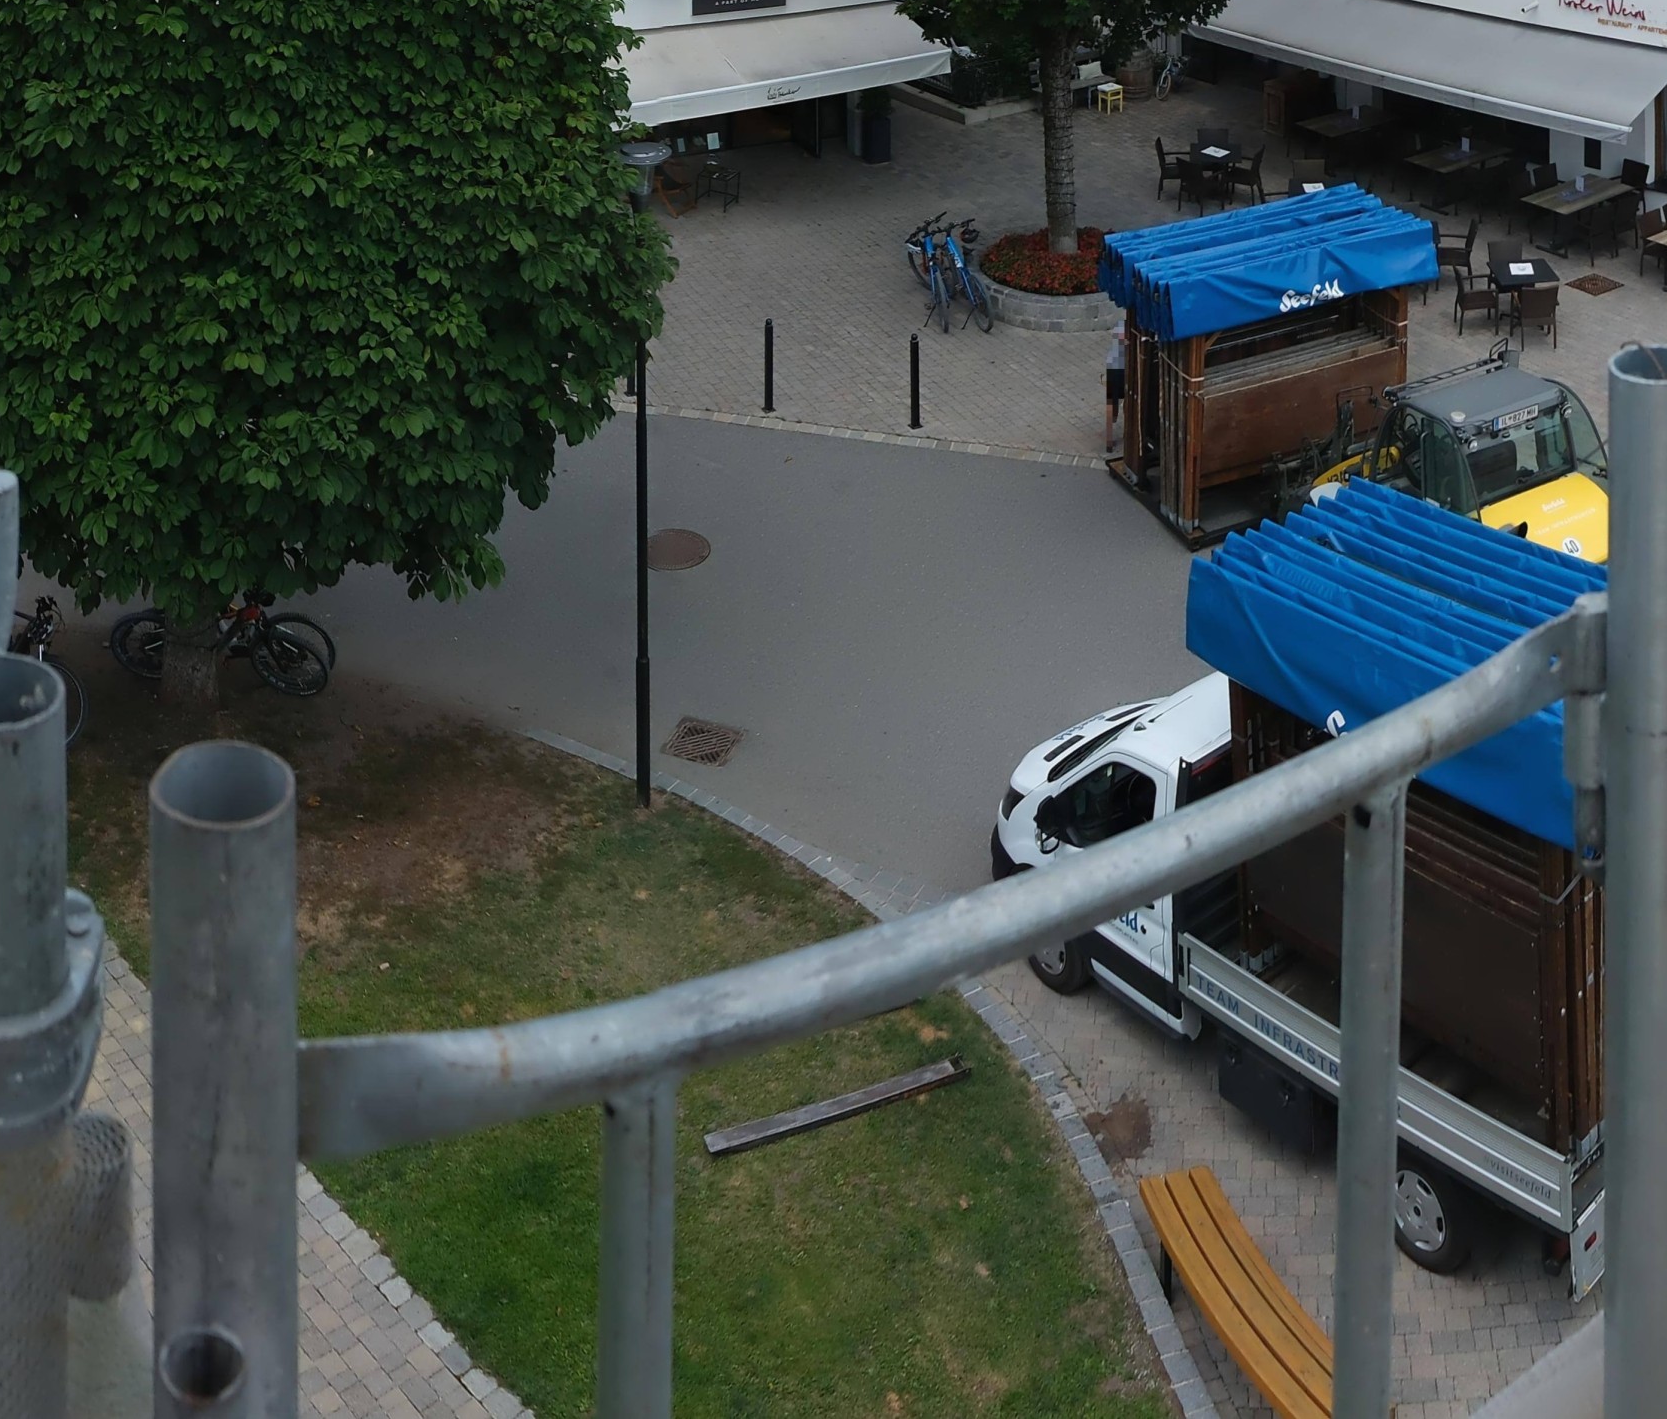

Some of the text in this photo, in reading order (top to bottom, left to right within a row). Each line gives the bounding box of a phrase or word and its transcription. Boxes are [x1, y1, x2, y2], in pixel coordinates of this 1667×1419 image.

[1279, 278, 1345, 313] Seefeld
[1564, 539, 1579, 554] 40
[1195, 975, 1341, 1081] TEAM INFRASTR
